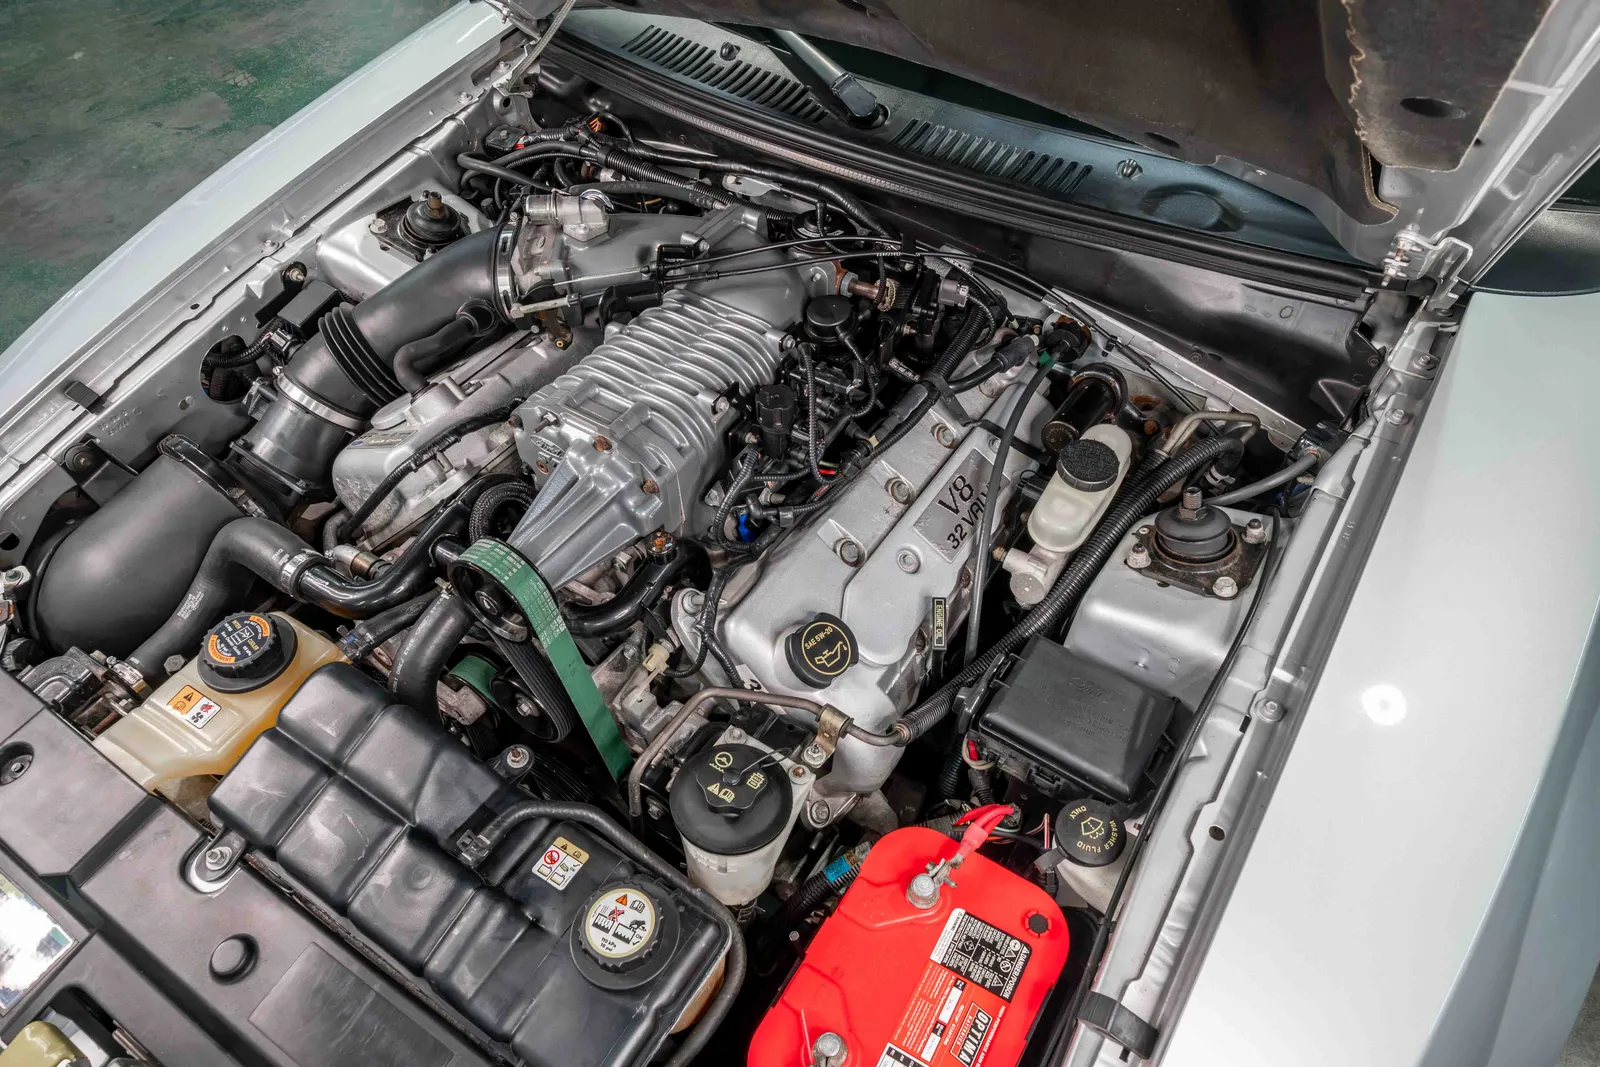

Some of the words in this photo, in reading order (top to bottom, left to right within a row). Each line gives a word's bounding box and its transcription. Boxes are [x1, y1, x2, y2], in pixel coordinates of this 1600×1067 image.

[938, 475, 974, 515] V8
[947, 524, 968, 550] 32
[962, 482, 1000, 526] VAL
[804, 638, 817, 649] SAE
[816, 626, 833, 642] 5W-20
[1070, 806, 1087, 819] ONLY
[1077, 841, 1101, 853] FLUID
[1104, 821, 1118, 850] WASHER
[1002, 952, 1026, 998] DANGER/POISON
[942, 1023, 955, 1045] STARTING
[956, 1015, 972, 1045] BATTERIES
[958, 1011, 989, 1062] OPTIMA
